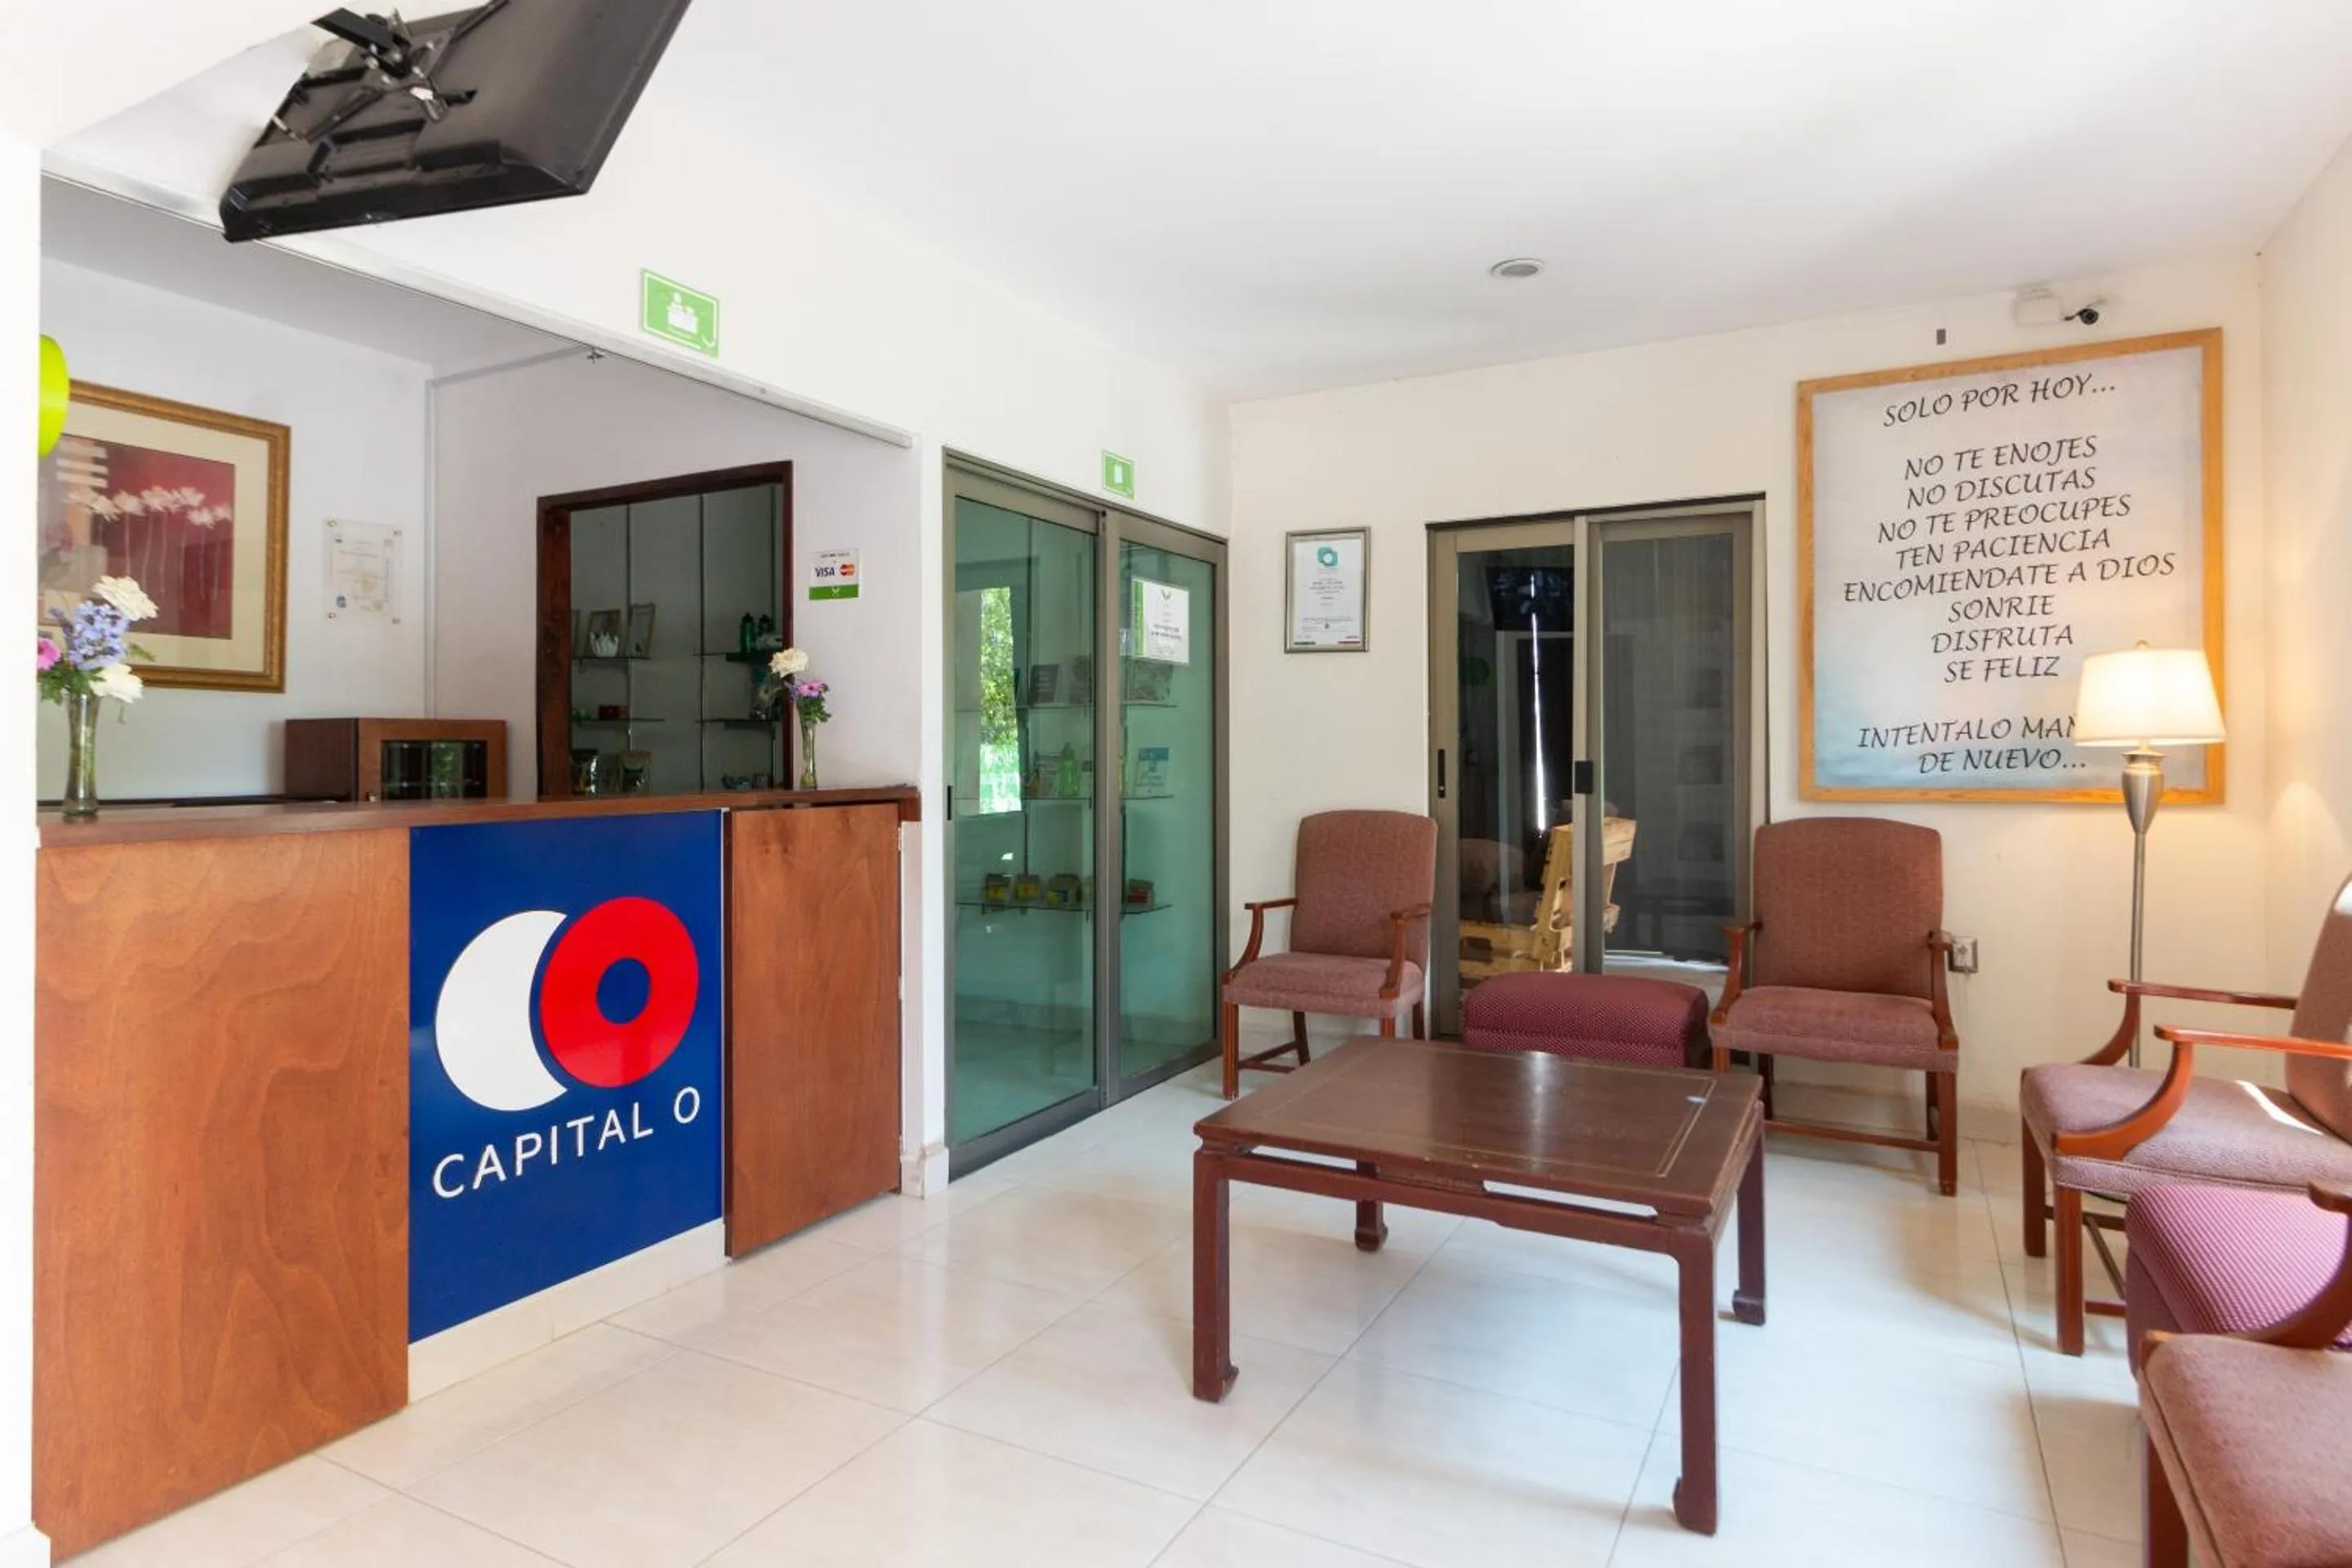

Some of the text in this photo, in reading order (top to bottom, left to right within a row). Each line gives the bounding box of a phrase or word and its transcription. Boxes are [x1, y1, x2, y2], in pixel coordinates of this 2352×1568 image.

[1883, 394, 1953, 427] SOLO
[1962, 384, 2019, 412] POR
[1904, 435, 2096, 480] NO TE ENOJES
[1908, 467, 2095, 510] NO DISCUTAS
[1878, 494, 2131, 543] NO TE PREOCUPES
[1896, 528, 2109, 569] TEN PACIENCIA
[815, 567, 835, 577] VISA
[1845, 553, 2175, 602] ENCOMIENDATE A DIOS
[1949, 595, 2054, 623] SONRIE
[1931, 625, 2073, 653] DISFRUTA
[1944, 656, 2060, 683] SE FELIZ
[1858, 719, 2011, 748] INTENTALO
[1918, 752, 1954, 773] DE
[432, 1086, 701, 1198] CAPITAL O
